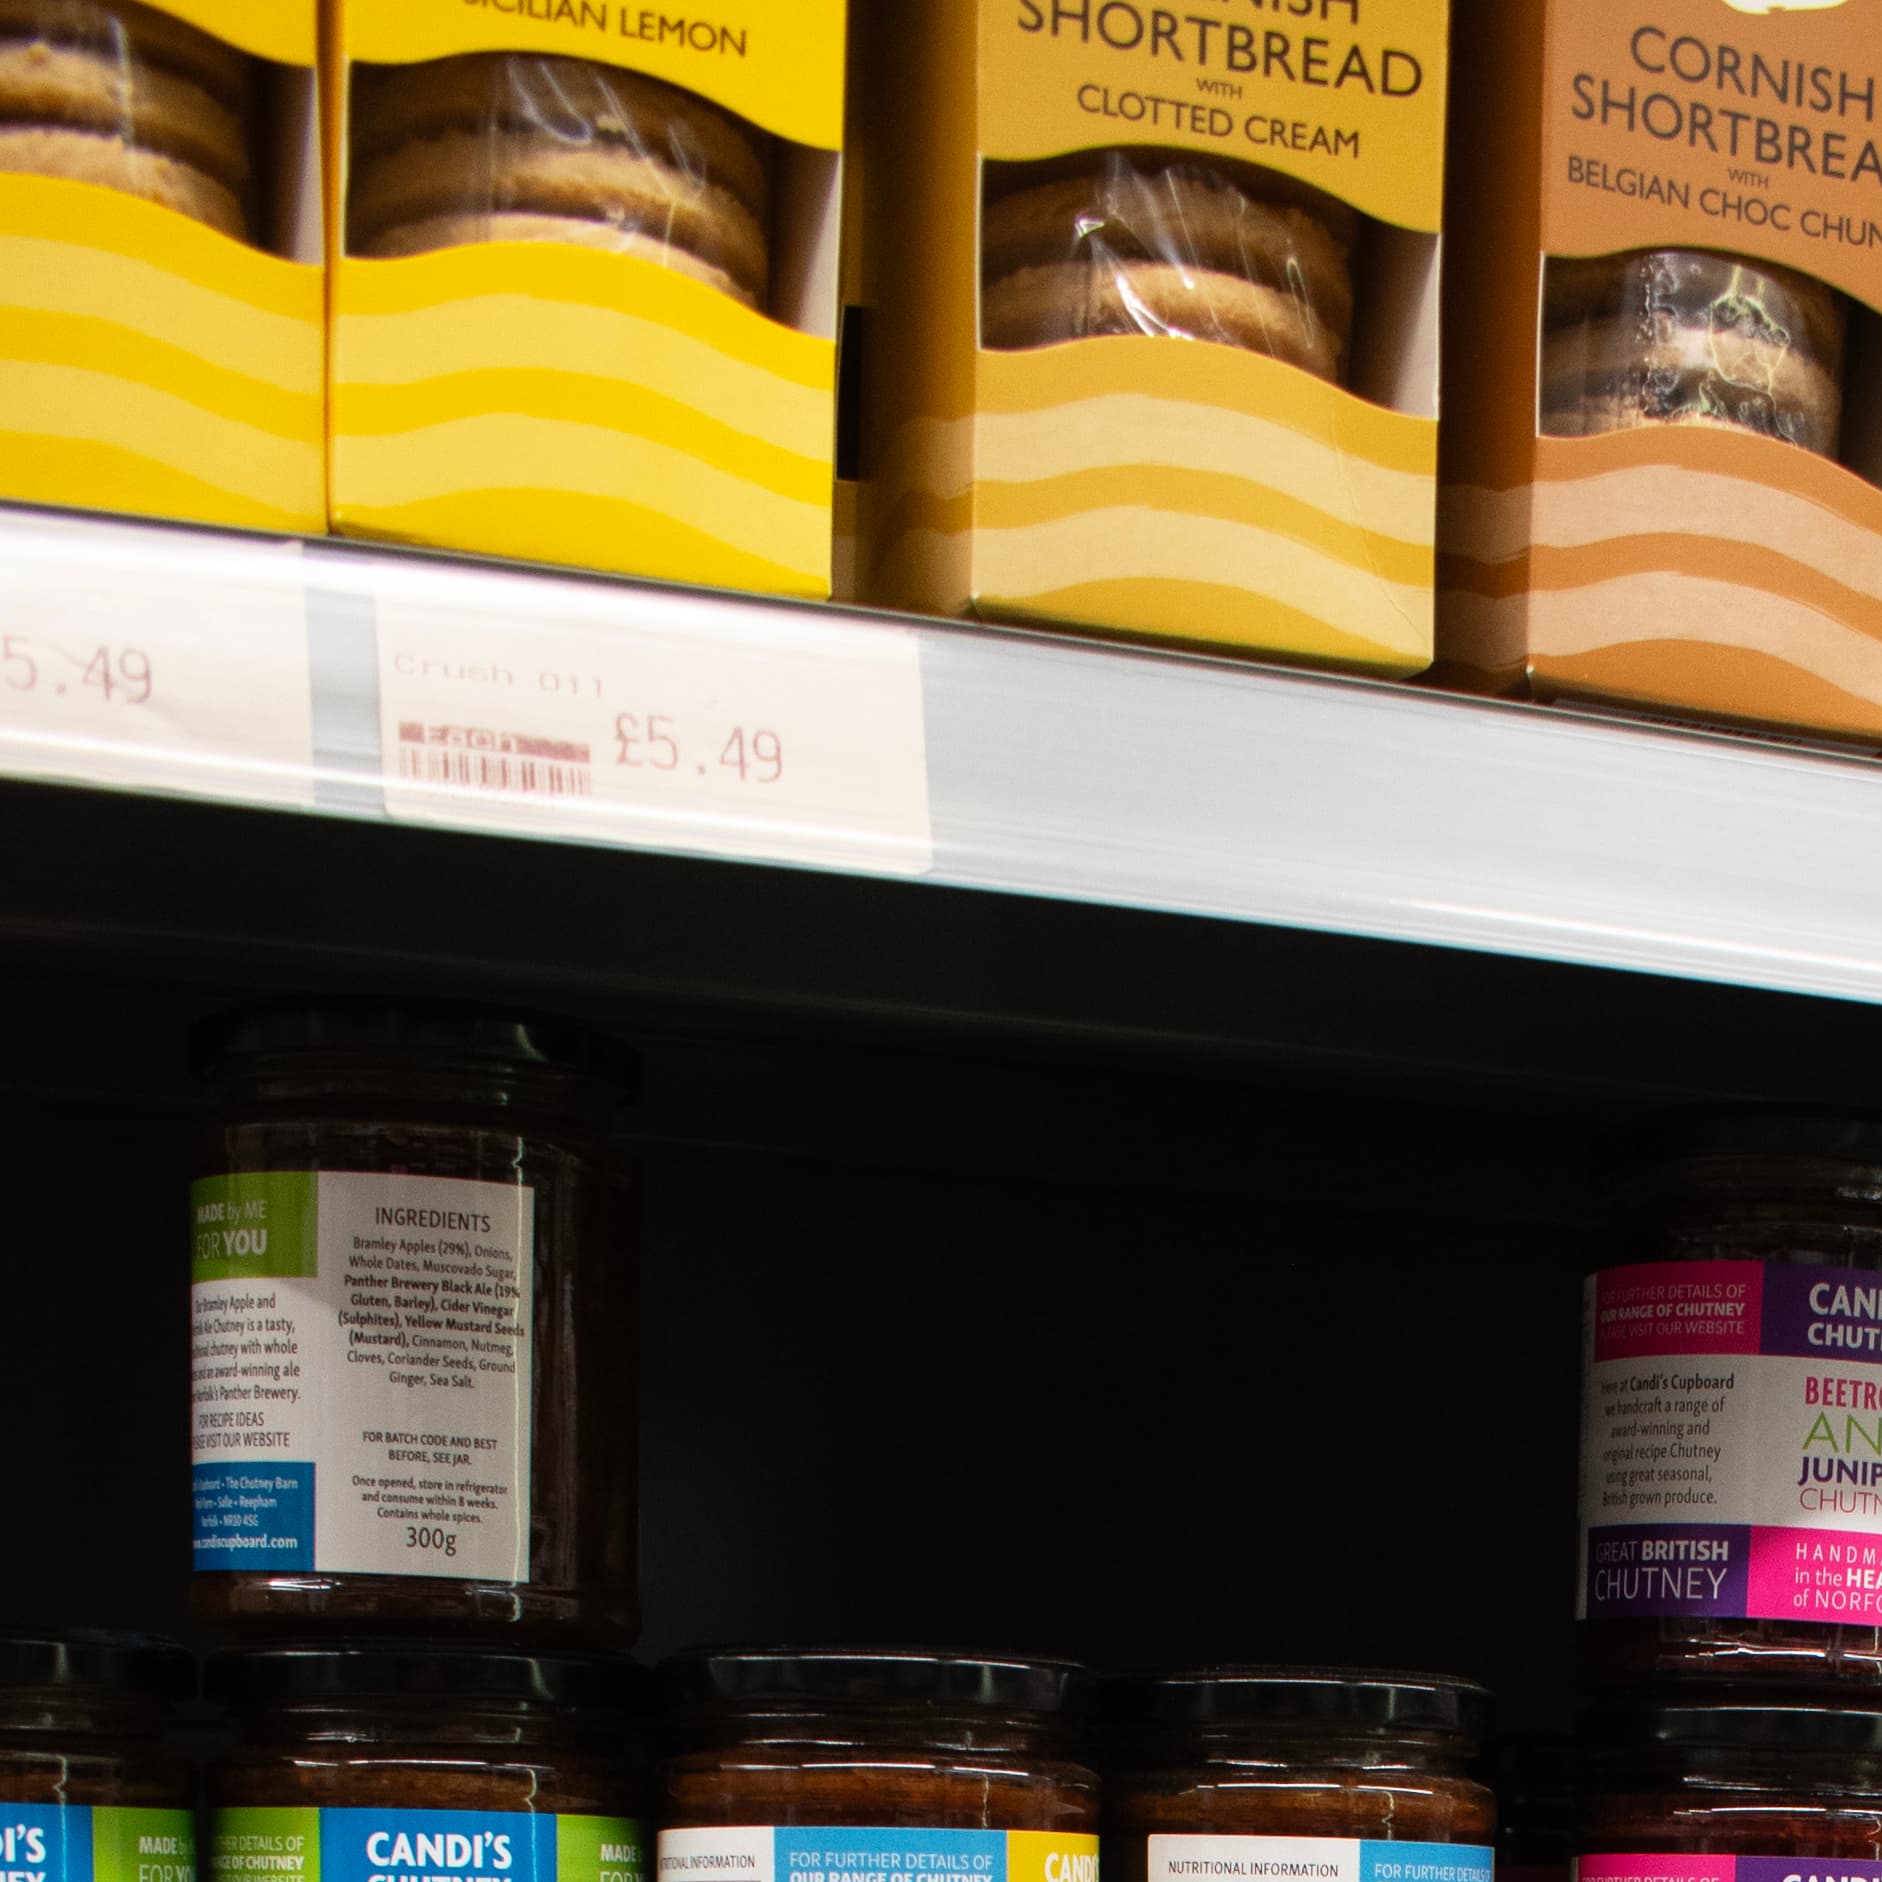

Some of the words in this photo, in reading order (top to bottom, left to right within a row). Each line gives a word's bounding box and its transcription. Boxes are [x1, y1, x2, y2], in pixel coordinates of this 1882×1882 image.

[620, 4, 748, 59] LEMON
[1018, 0, 1422, 98] SHORTBREAD
[1196, 78, 1242, 100] WITH
[1077, 83, 1233, 138] CLOTTED
[1244, 115, 1359, 158] CREAM
[1567, 156, 1691, 212] BELGIAN
[1700, 189, 1791, 231] CHOC
[395, 655, 513, 688] Crush
[615, 712, 783, 784] £5.49
[376, 1207, 491, 1233] INGREDIENTS
[353, 1236, 397, 1253] Bramley
[400, 1239, 435, 1255] Apples
[407, 1527, 456, 1556] 300g
[367, 1831, 512, 1869] CANDI'S
[1169, 1861, 1247, 1876] NUTRITIONAL
[1250, 1861, 1338, 1878] INFORMATION
